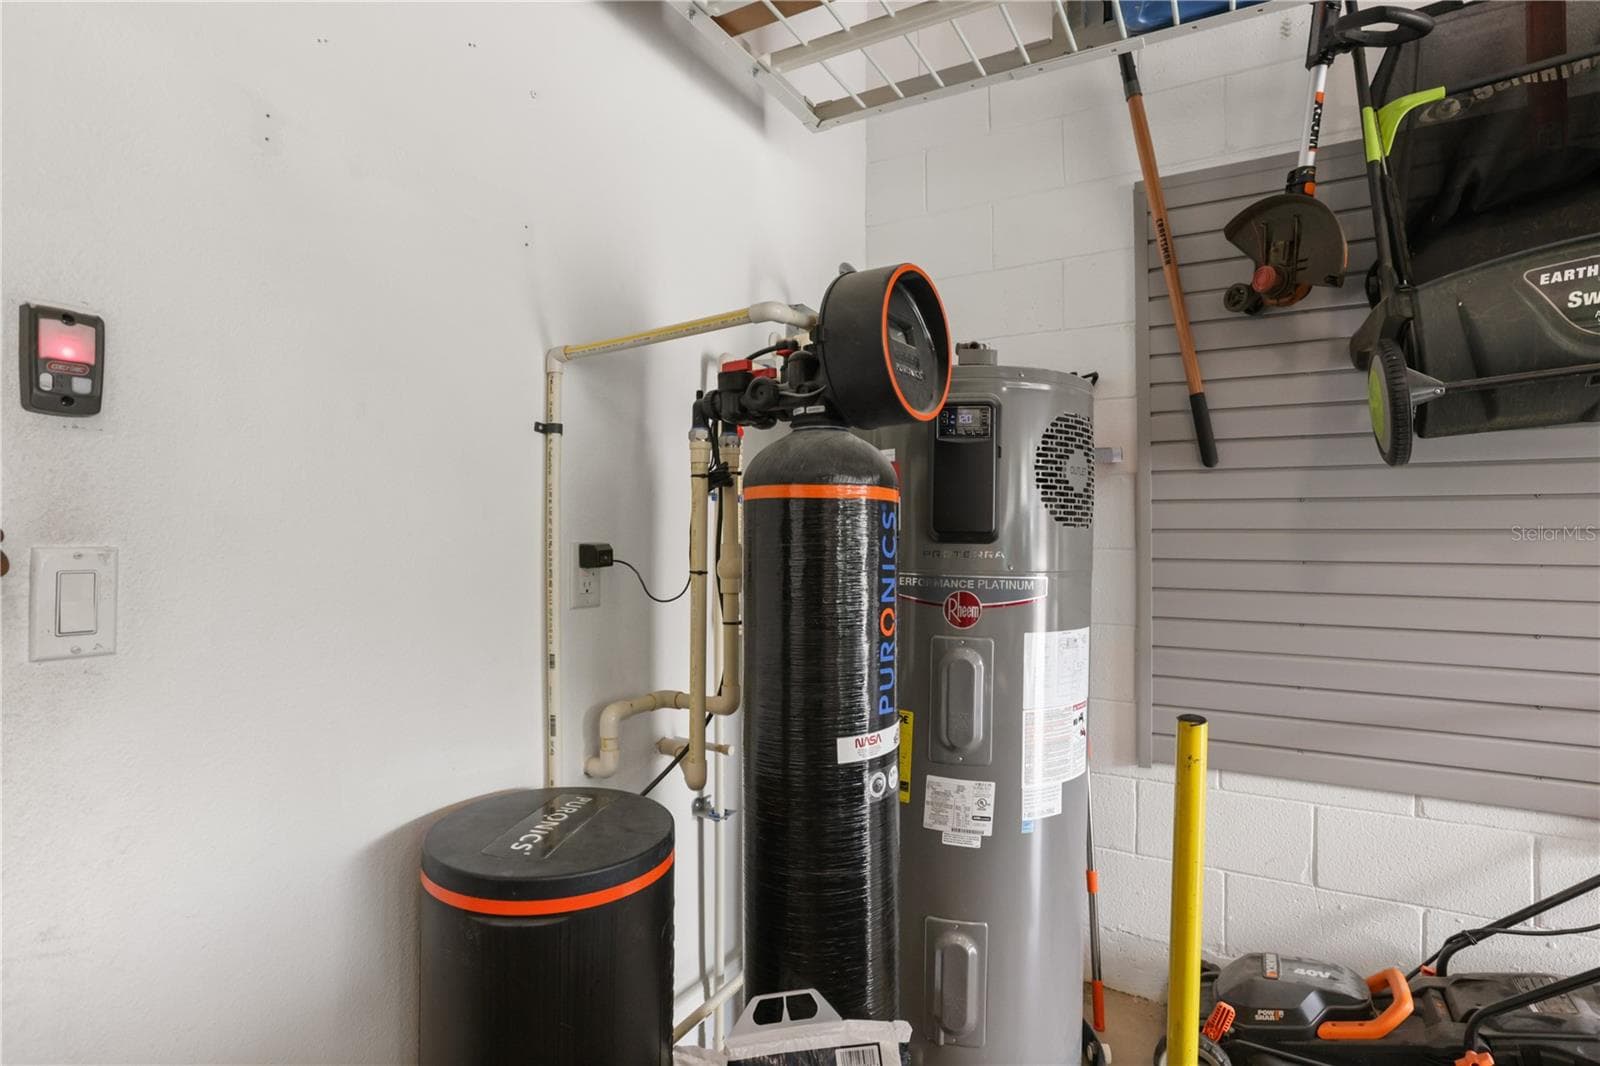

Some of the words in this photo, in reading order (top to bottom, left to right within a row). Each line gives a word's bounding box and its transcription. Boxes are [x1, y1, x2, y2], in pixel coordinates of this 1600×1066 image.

[1309, 101, 1323, 150] WORX
[977, 579, 1035, 591] PLATINUM
[878, 510, 897, 716] PURONICS
[948, 591, 979, 623] Rheem
[855, 733, 882, 749] NASA
[510, 796, 593, 852] PURONICS
